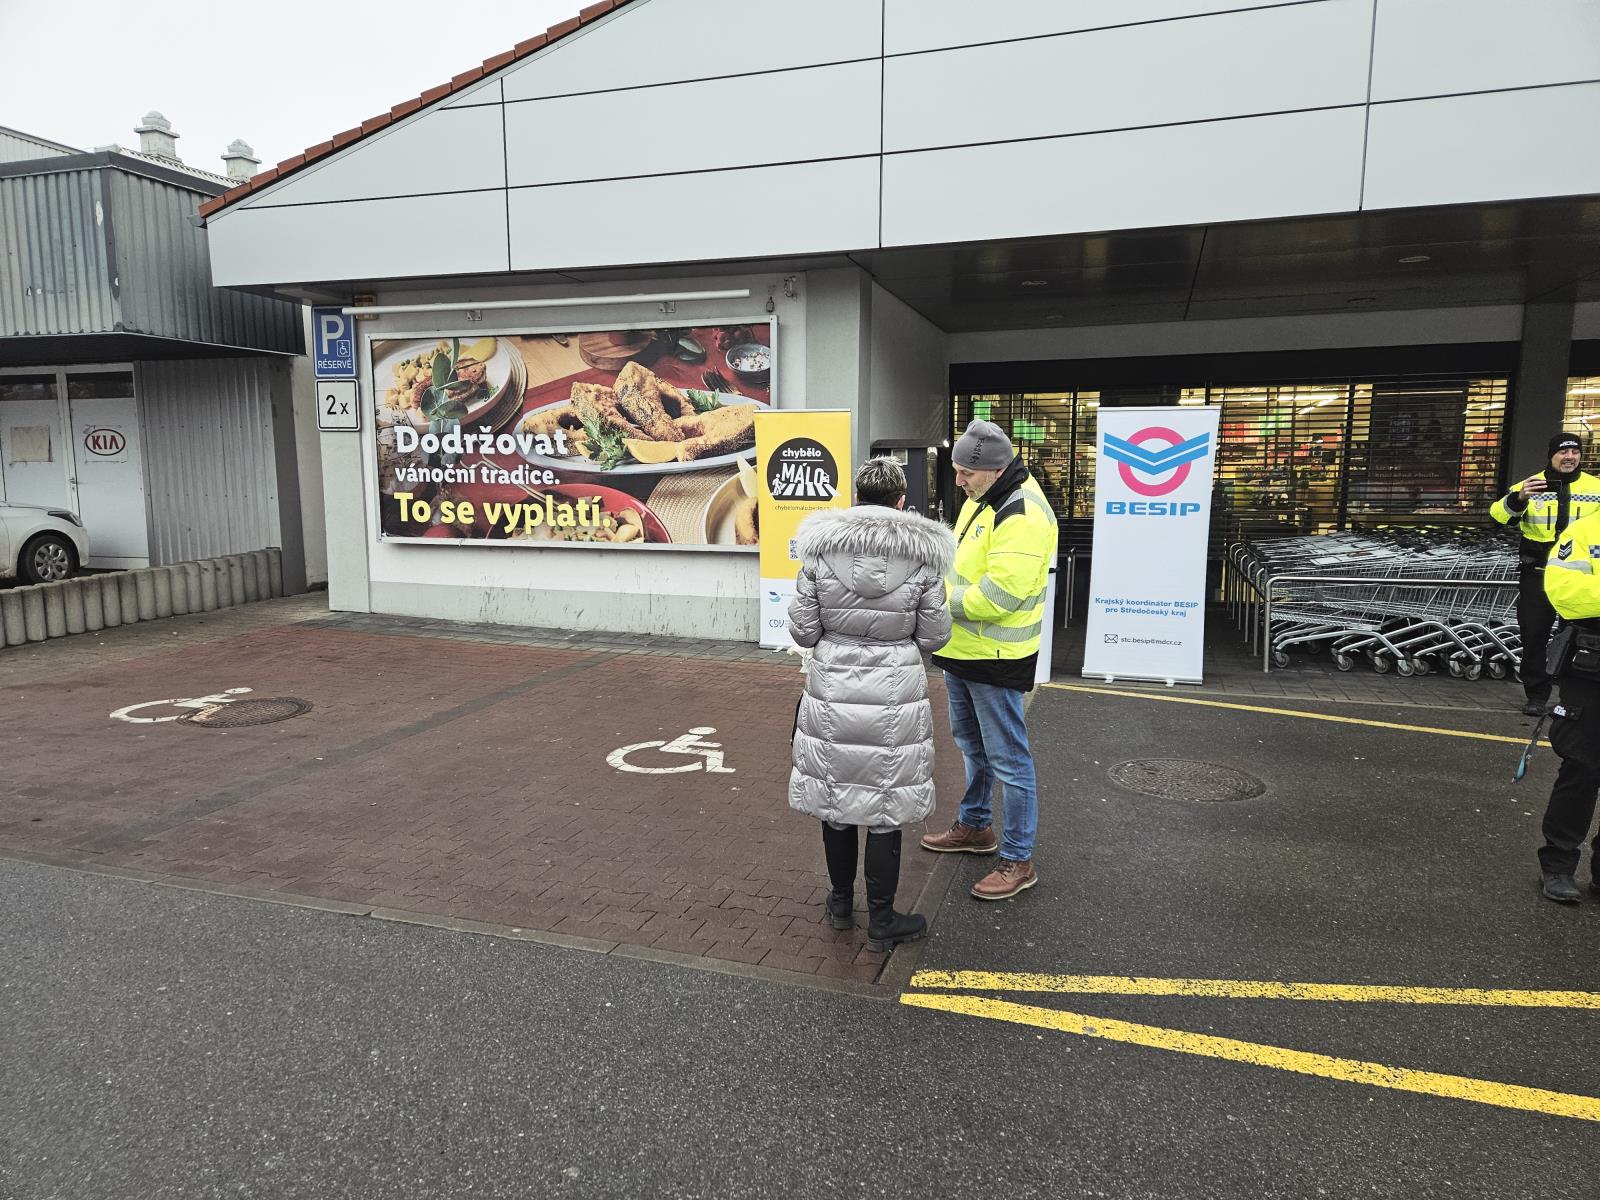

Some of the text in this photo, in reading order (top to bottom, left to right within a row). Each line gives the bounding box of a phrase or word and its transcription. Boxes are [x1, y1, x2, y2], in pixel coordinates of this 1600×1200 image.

[320, 314, 345, 355] P
[317, 358, 352, 369] RÉSERVÉ
[91, 435, 120, 450] KIA
[393, 424, 568, 455] Dodržovat
[782, 447, 822, 459] chybělo
[394, 462, 561, 485] vánoční tradice.
[393, 492, 611, 535] To se vyplatí.
[1105, 501, 1201, 516] BESIP
[1095, 597, 1199, 609] Krajský koordinátor BESIP
[1120, 607, 1169, 617] Středočeský
[1171, 610, 1187, 618] kraj
